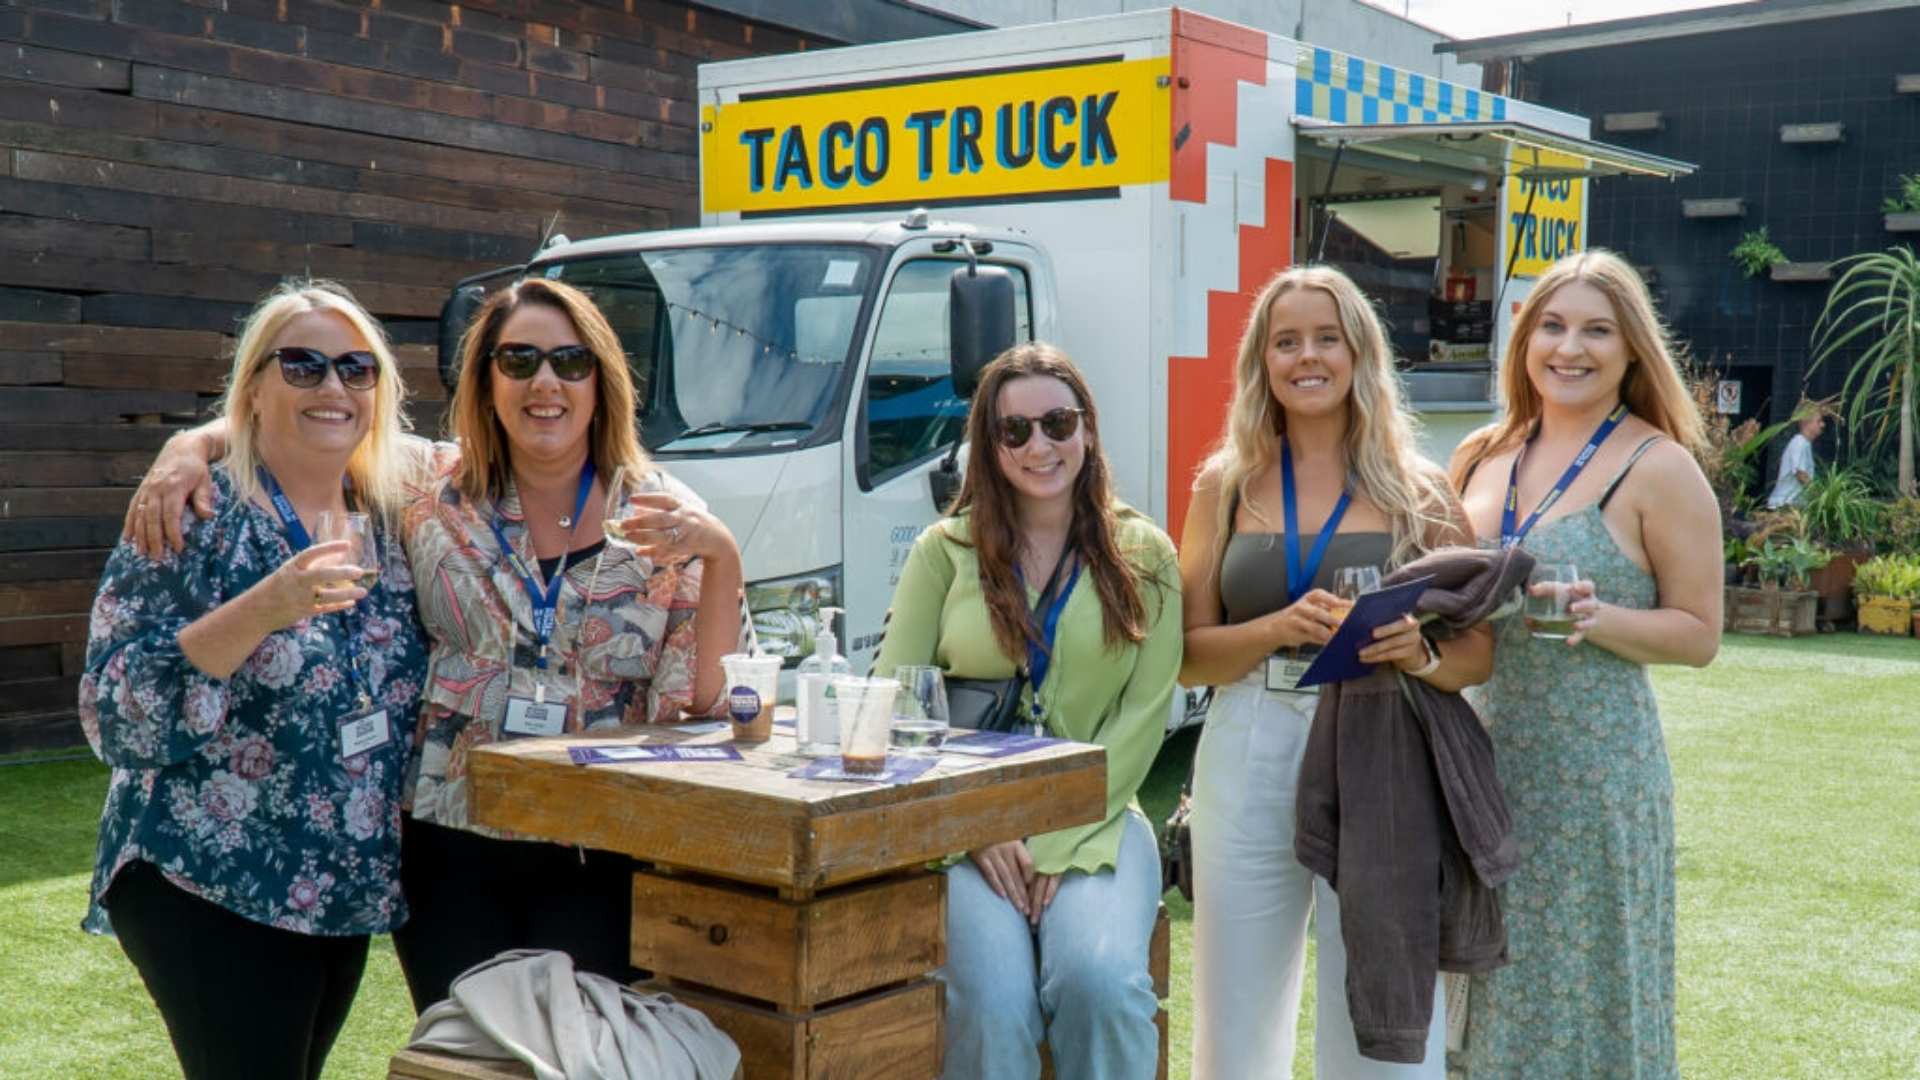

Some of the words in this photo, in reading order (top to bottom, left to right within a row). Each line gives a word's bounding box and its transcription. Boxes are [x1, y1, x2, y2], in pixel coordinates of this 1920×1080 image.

[740, 116, 890, 192] TACO
[906, 91, 1119, 181] TRUCK
[1511, 212, 1577, 260] TRUCK
